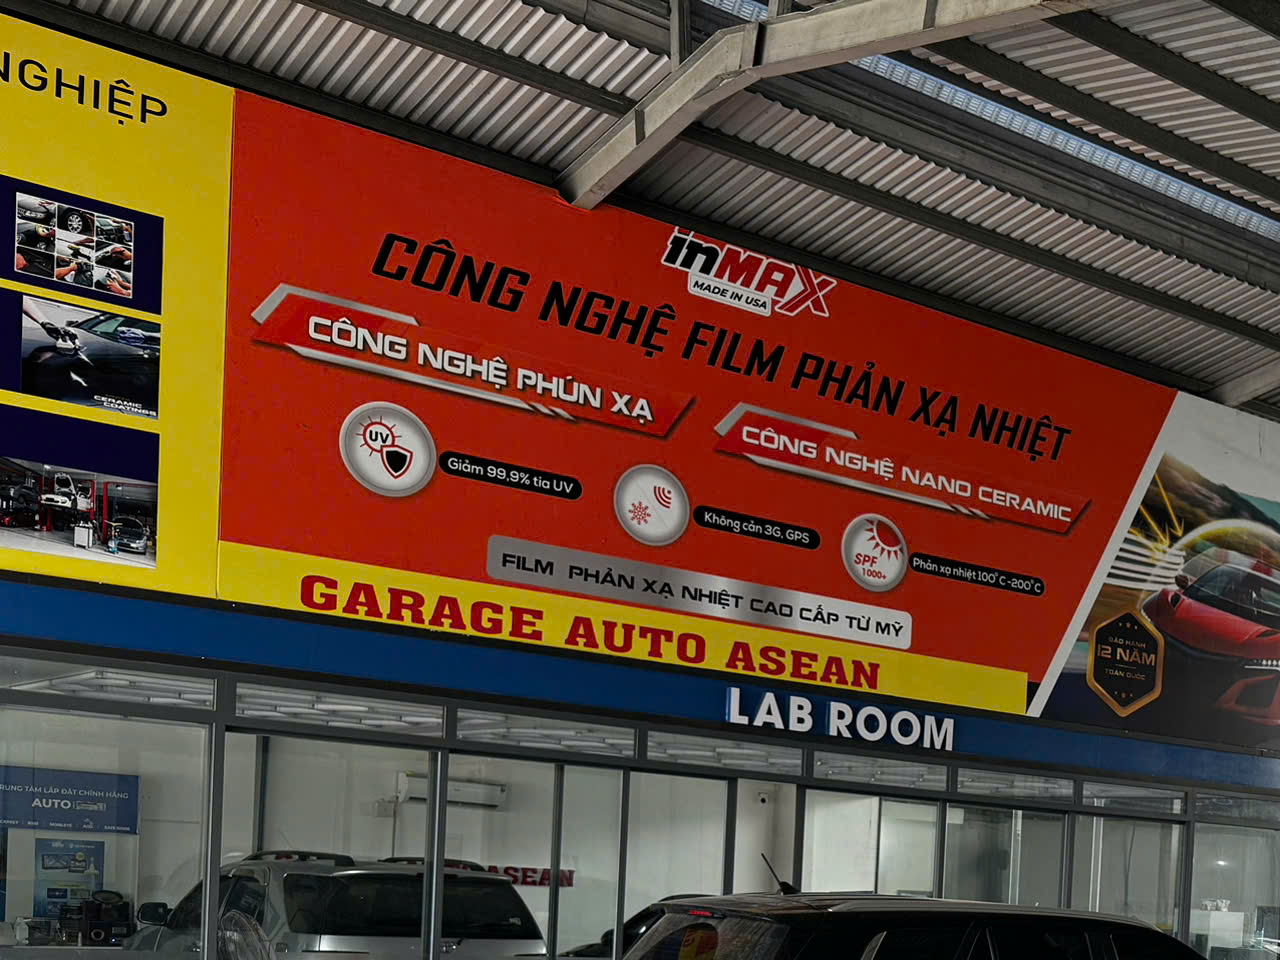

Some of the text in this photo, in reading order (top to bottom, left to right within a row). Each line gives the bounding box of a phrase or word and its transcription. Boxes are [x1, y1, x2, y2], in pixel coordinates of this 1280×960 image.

[693, 280, 768, 310] MADE IN USA
[371, 232, 1072, 462] CÔNG NGHỆ FILM PHẢN XẠ NHIỆT
[309, 315, 653, 423] CÔNG NGHỆ PHÚN XẠ
[94, 395, 143, 408] CERAMIC
[369, 430, 390, 444] UV
[447, 457, 484, 475] Giảm
[533, 476, 550, 489] tia
[553, 480, 574, 494] UV
[742, 426, 1072, 522] CÔNG NGHỆ NANO CERAMIC
[704, 511, 740, 532] Không
[742, 520, 763, 534] cản
[786, 529, 810, 543] GPS
[854, 552, 879, 568] SPF
[862, 568, 887, 580] 1000+
[913, 557, 938, 572] Phản
[939, 566, 951, 577] xạ
[953, 568, 976, 580] nhiệt
[502, 553, 903, 637] FILM PHẢN XẠ NHIỆT CAO CẤP TỪ MỸ
[300, 574, 880, 691] GARAGE AUTO ASEAN
[727, 687, 954, 751] LAB ROOM
[31, 798, 72, 809] AUTO
